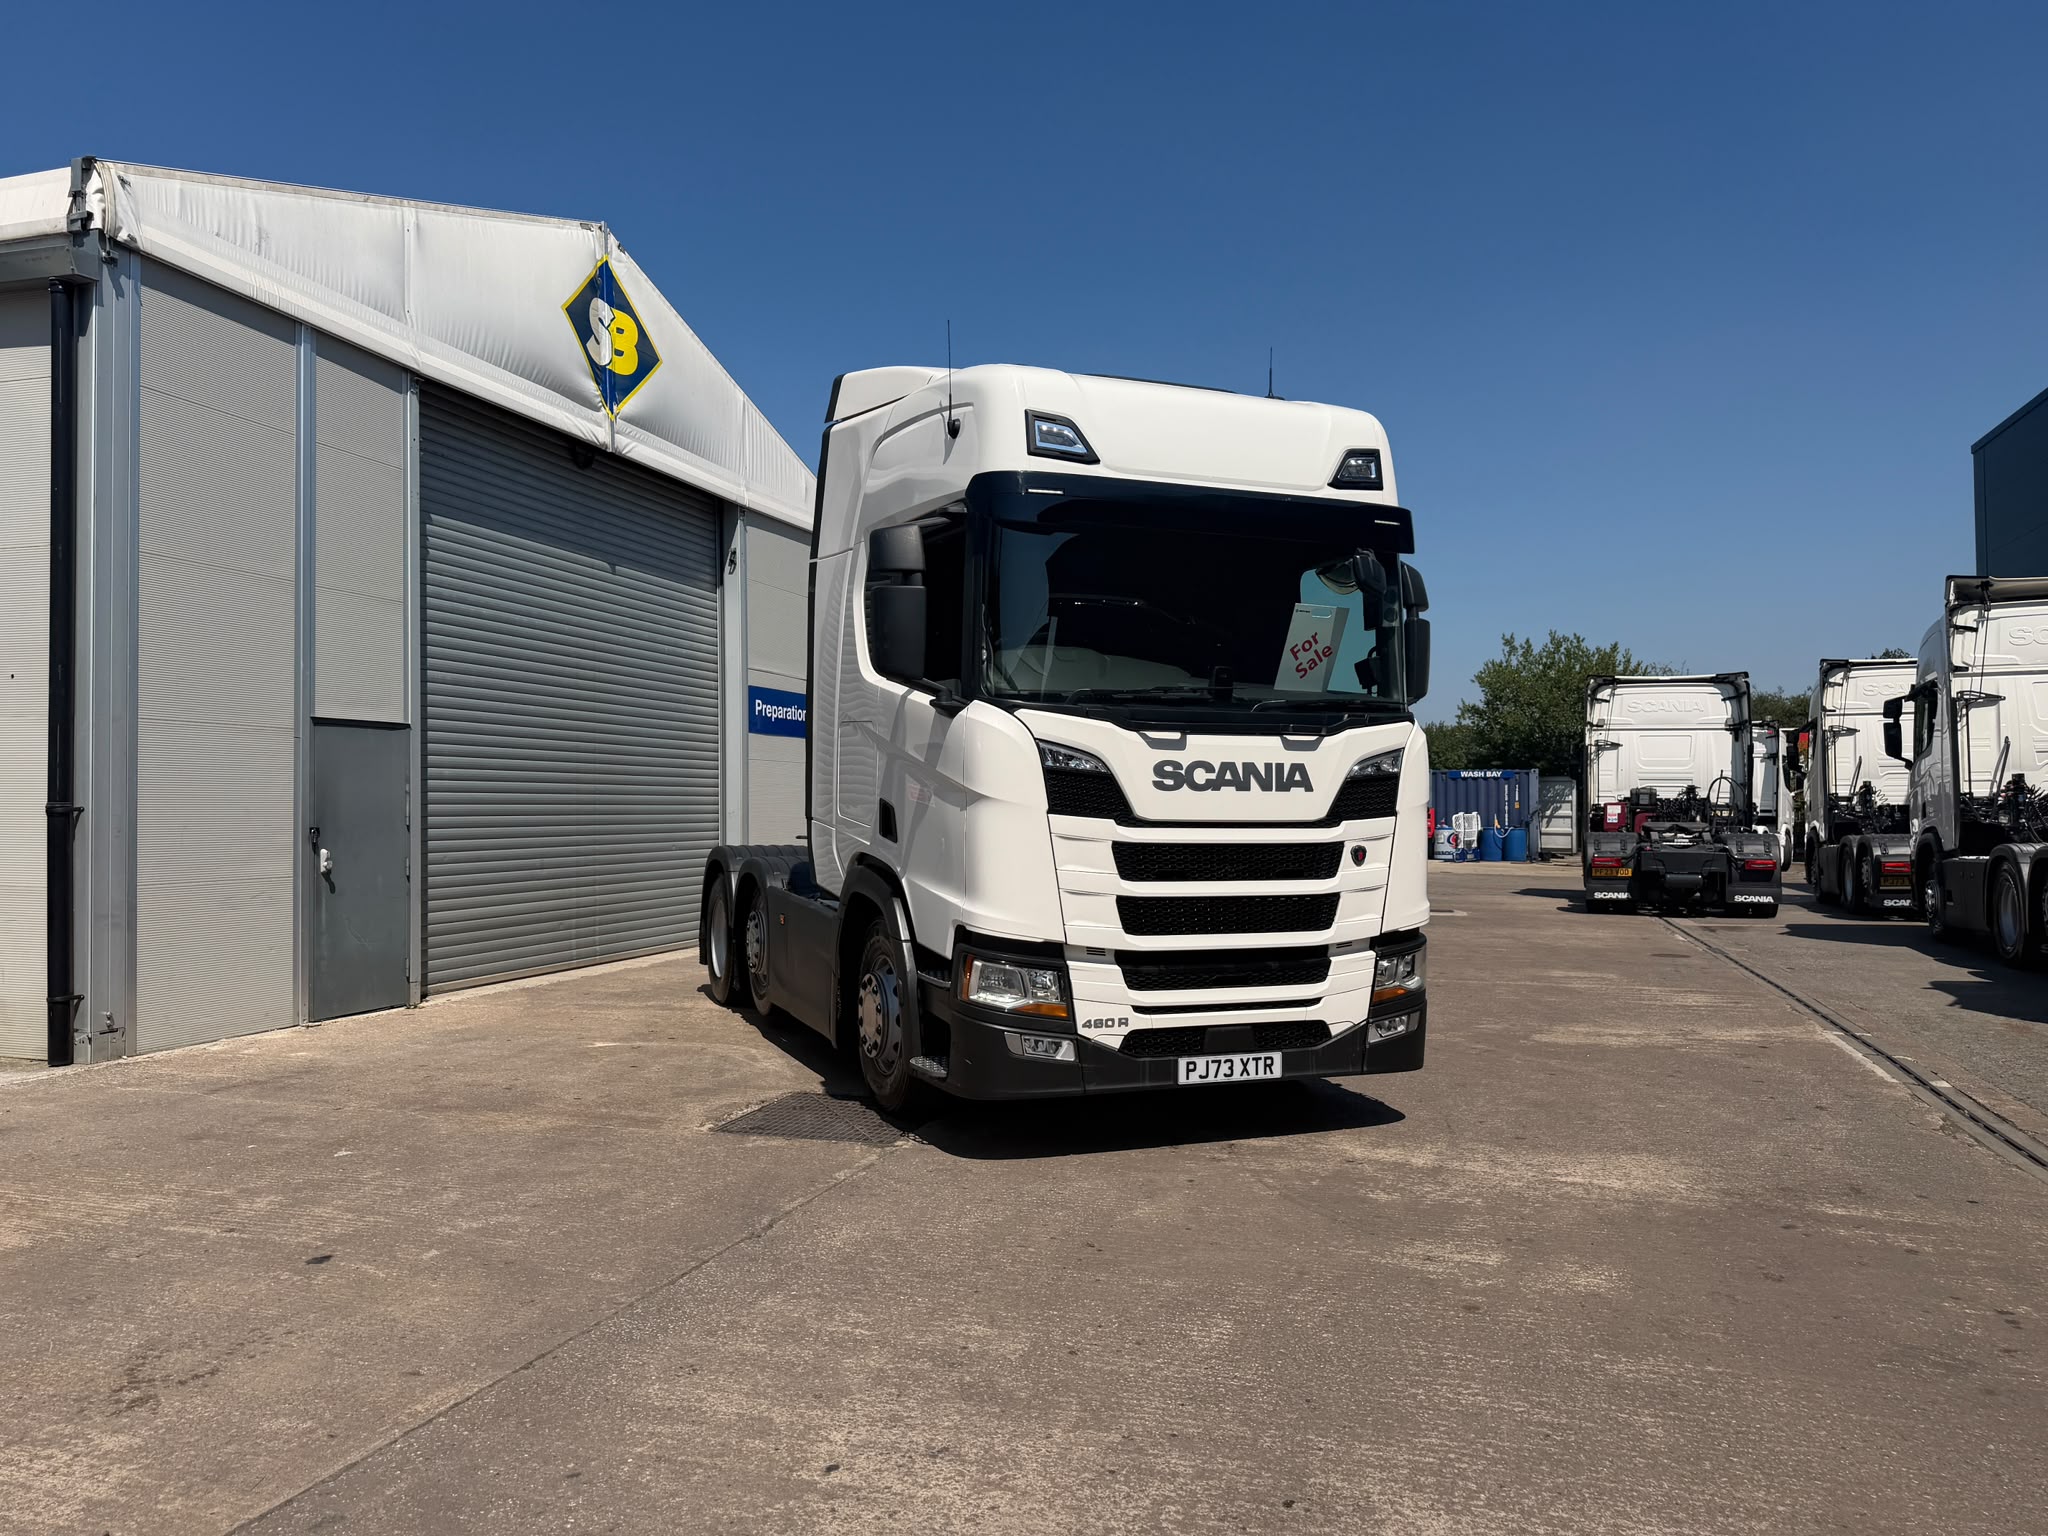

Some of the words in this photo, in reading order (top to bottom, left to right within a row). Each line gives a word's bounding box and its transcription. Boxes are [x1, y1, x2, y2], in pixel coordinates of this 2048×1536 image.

[1289, 631, 1319, 661] For
[1295, 645, 1333, 679] Sale
[1862, 682, 1909, 696] SCA
[1627, 699, 1704, 713] SCANIA
[1152, 760, 1314, 793] SCANIA
[1734, 895, 1774, 903] SCANIA
[1117, 1017, 1129, 1028] R
[1186, 1058, 1234, 1080] PJ73
[1239, 1056, 1274, 1077] XTR
